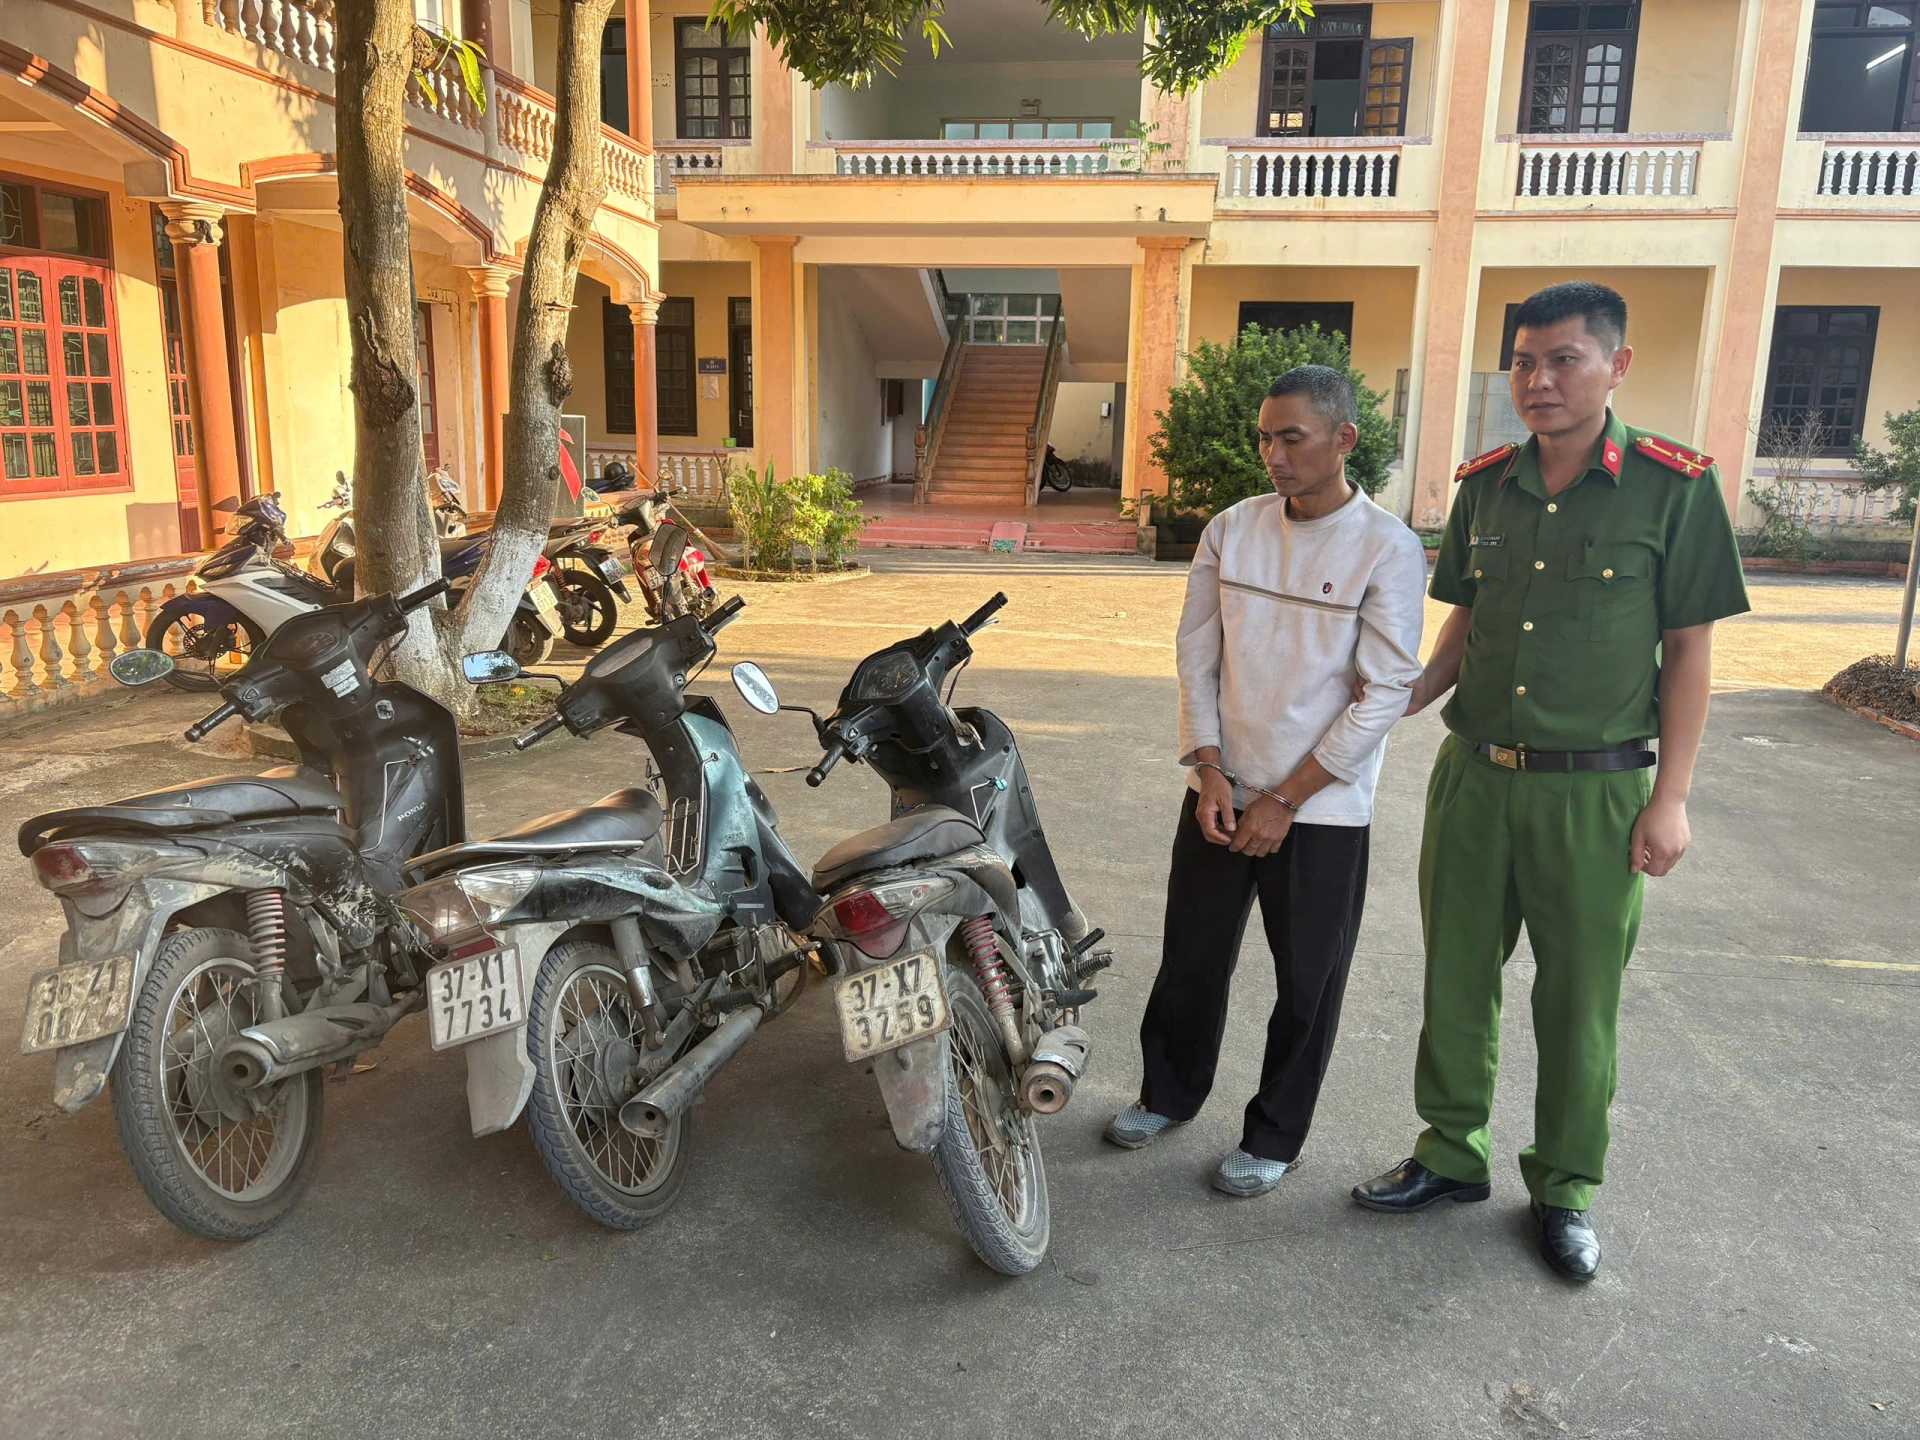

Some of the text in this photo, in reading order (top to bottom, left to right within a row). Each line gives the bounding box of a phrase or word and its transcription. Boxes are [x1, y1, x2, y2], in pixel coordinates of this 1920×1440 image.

[440, 951, 505, 1003] 37-X1
[849, 958, 920, 1012] 37-X7
[443, 988, 512, 1041] 7734
[856, 994, 936, 1050] 3259
